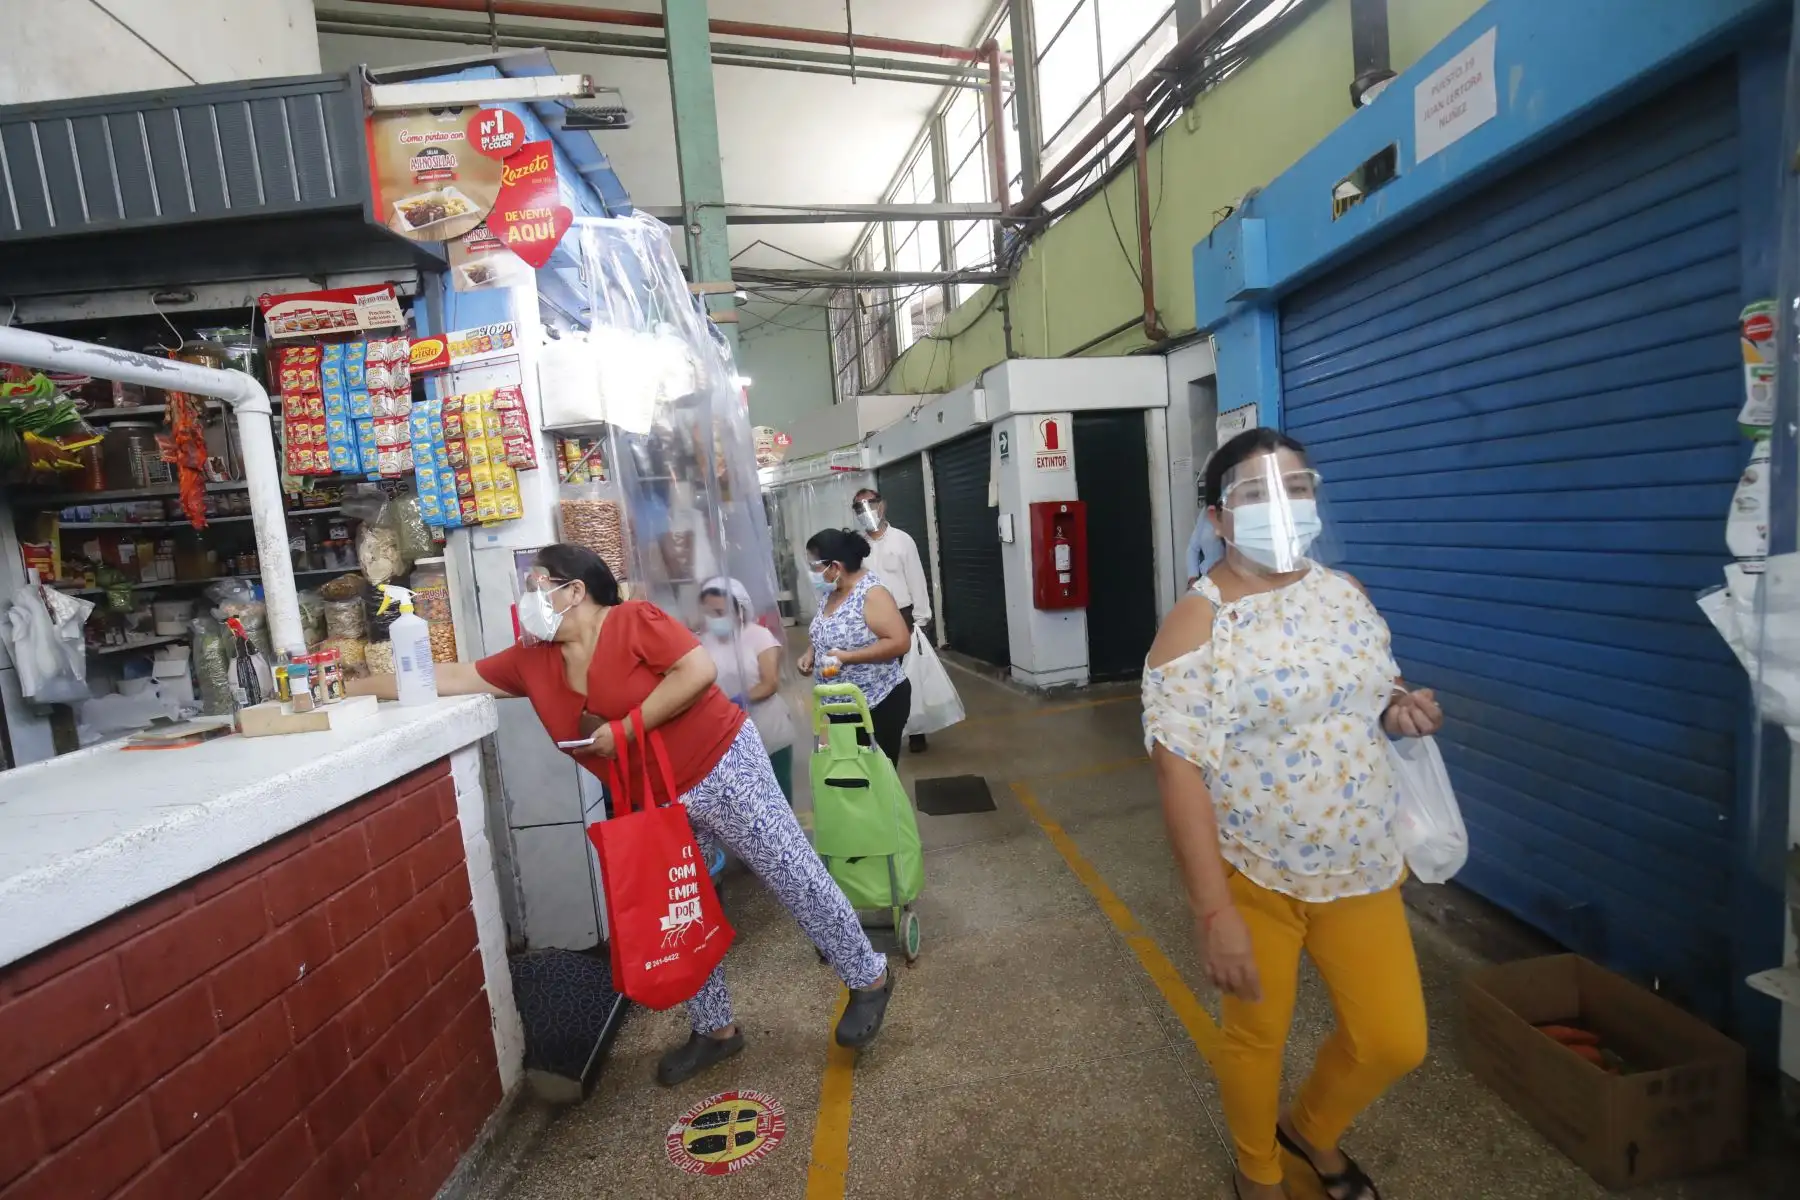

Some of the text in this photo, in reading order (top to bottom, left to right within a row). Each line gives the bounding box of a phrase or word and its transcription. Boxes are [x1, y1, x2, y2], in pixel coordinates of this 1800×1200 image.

[400, 129, 423, 144] Como
[450, 132, 464, 140] con
[491, 132, 514, 141] SABOR
[482, 140, 512, 151] Y COLOR
[502, 154, 549, 186] Razzeto
[504, 207, 552, 222] DE VENTA
[508, 218, 556, 243] AQUÍ
[1037, 455, 1067, 468] EXTINTOR
[682, 845, 693, 859] EL
[675, 901, 695, 919] POR
[772, 1120, 786, 1133] TU
